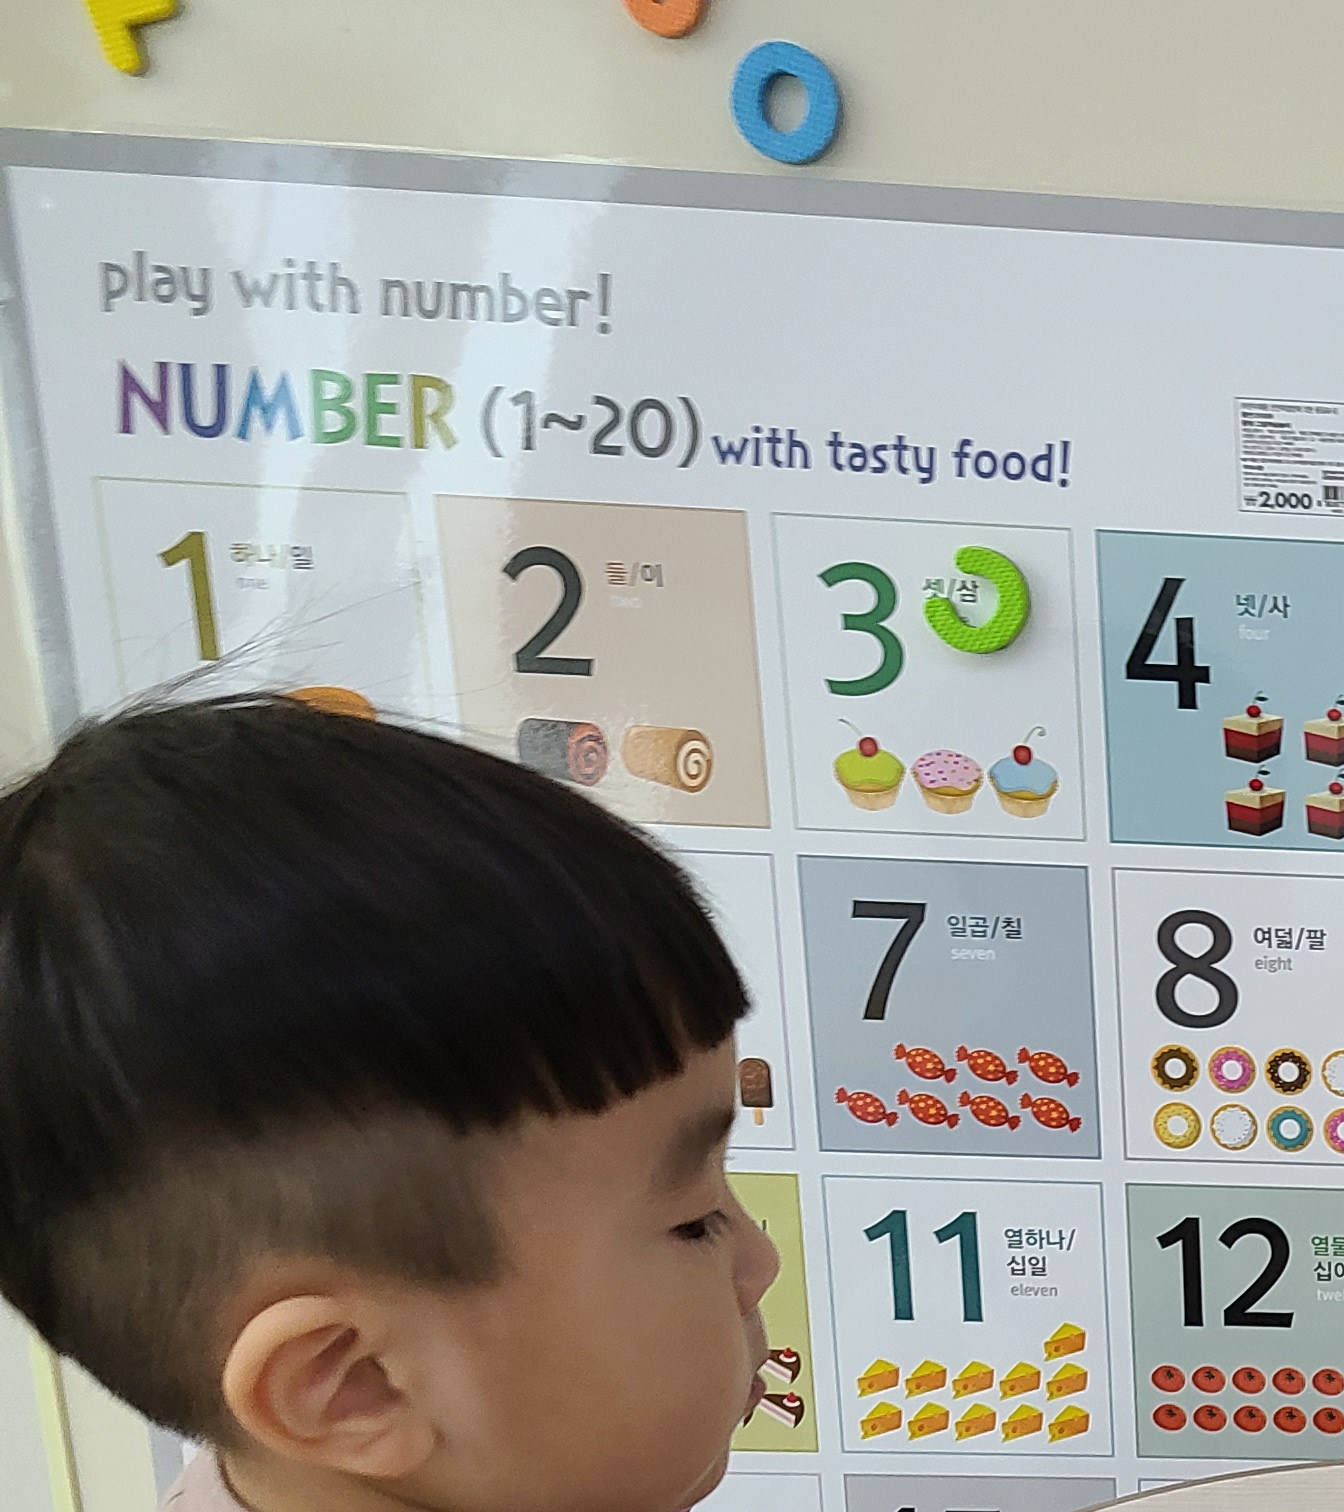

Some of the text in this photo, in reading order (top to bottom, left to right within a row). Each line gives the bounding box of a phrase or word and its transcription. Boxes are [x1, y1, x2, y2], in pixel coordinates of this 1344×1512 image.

[100, 251, 613, 335] play with number!
[117, 360, 1072, 488] NUMBER (1~20) with tasty food!
[157, 531, 222, 662] 1
[503, 545, 594, 677] 2
[816, 560, 906, 697] 3
[1125, 577, 1211, 710] 4
[1236, 594, 1291, 618] 넷/사
[850, 899, 927, 1022] 7
[946, 915, 1025, 941] 일곱/칠
[950, 948, 996, 962] seven
[1155, 909, 1240, 1029] 8
[1253, 926, 1327, 952] 여덟/팔
[1254, 956, 1293, 973] eight
[862, 1209, 985, 1324] 11
[1003, 1228, 1076, 1251] 열하나/
[1006, 1255, 1048, 1278] 십일
[1156, 1216, 1295, 1328] 12
[1010, 1283, 1058, 1298] eleven
